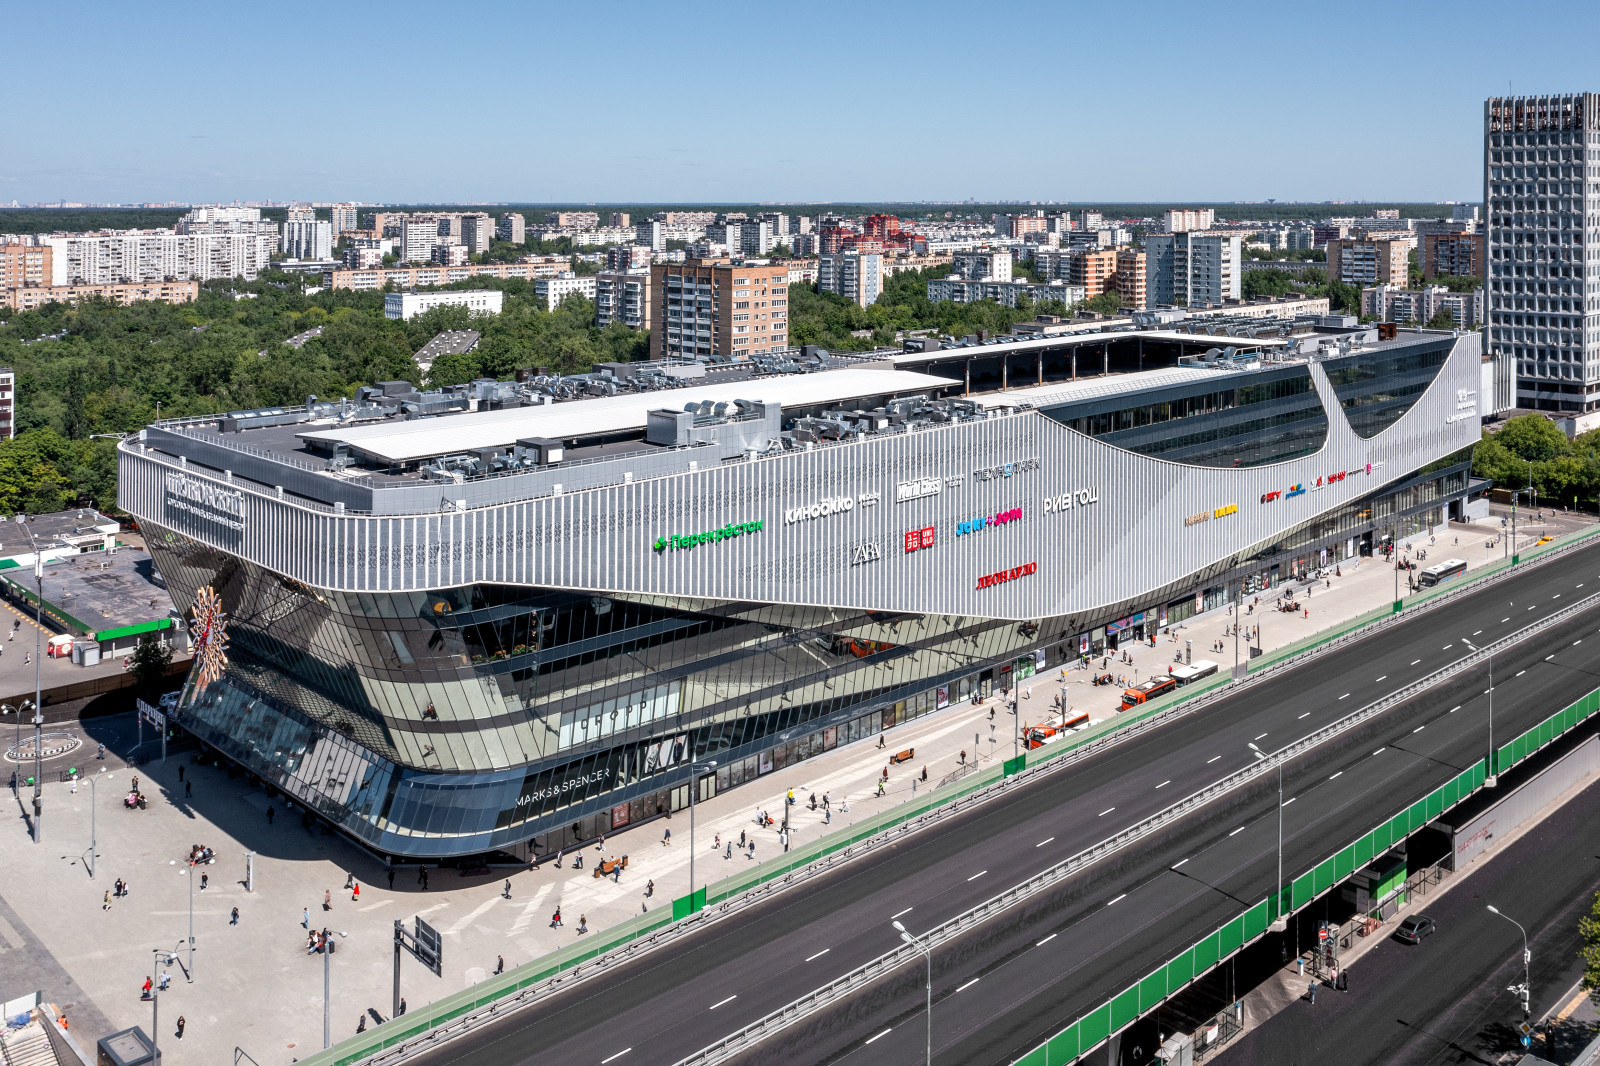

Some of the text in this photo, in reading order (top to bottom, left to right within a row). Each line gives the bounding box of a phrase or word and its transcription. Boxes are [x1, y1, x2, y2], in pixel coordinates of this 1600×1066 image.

[921, 477, 942, 496] Class
[1043, 493, 1071, 515] РИВ
[922, 528, 933, 538] UNI
[956, 507, 1022, 536] JOKI JOYA
[671, 519, 763, 549] Перекрёсток
[922, 536, 933, 546] QLO
[852, 542, 880, 565] ZARA
[976, 562, 1037, 589] ЛЕОНАРДО
[515, 768, 610, 808] MARKS & SPENCER
